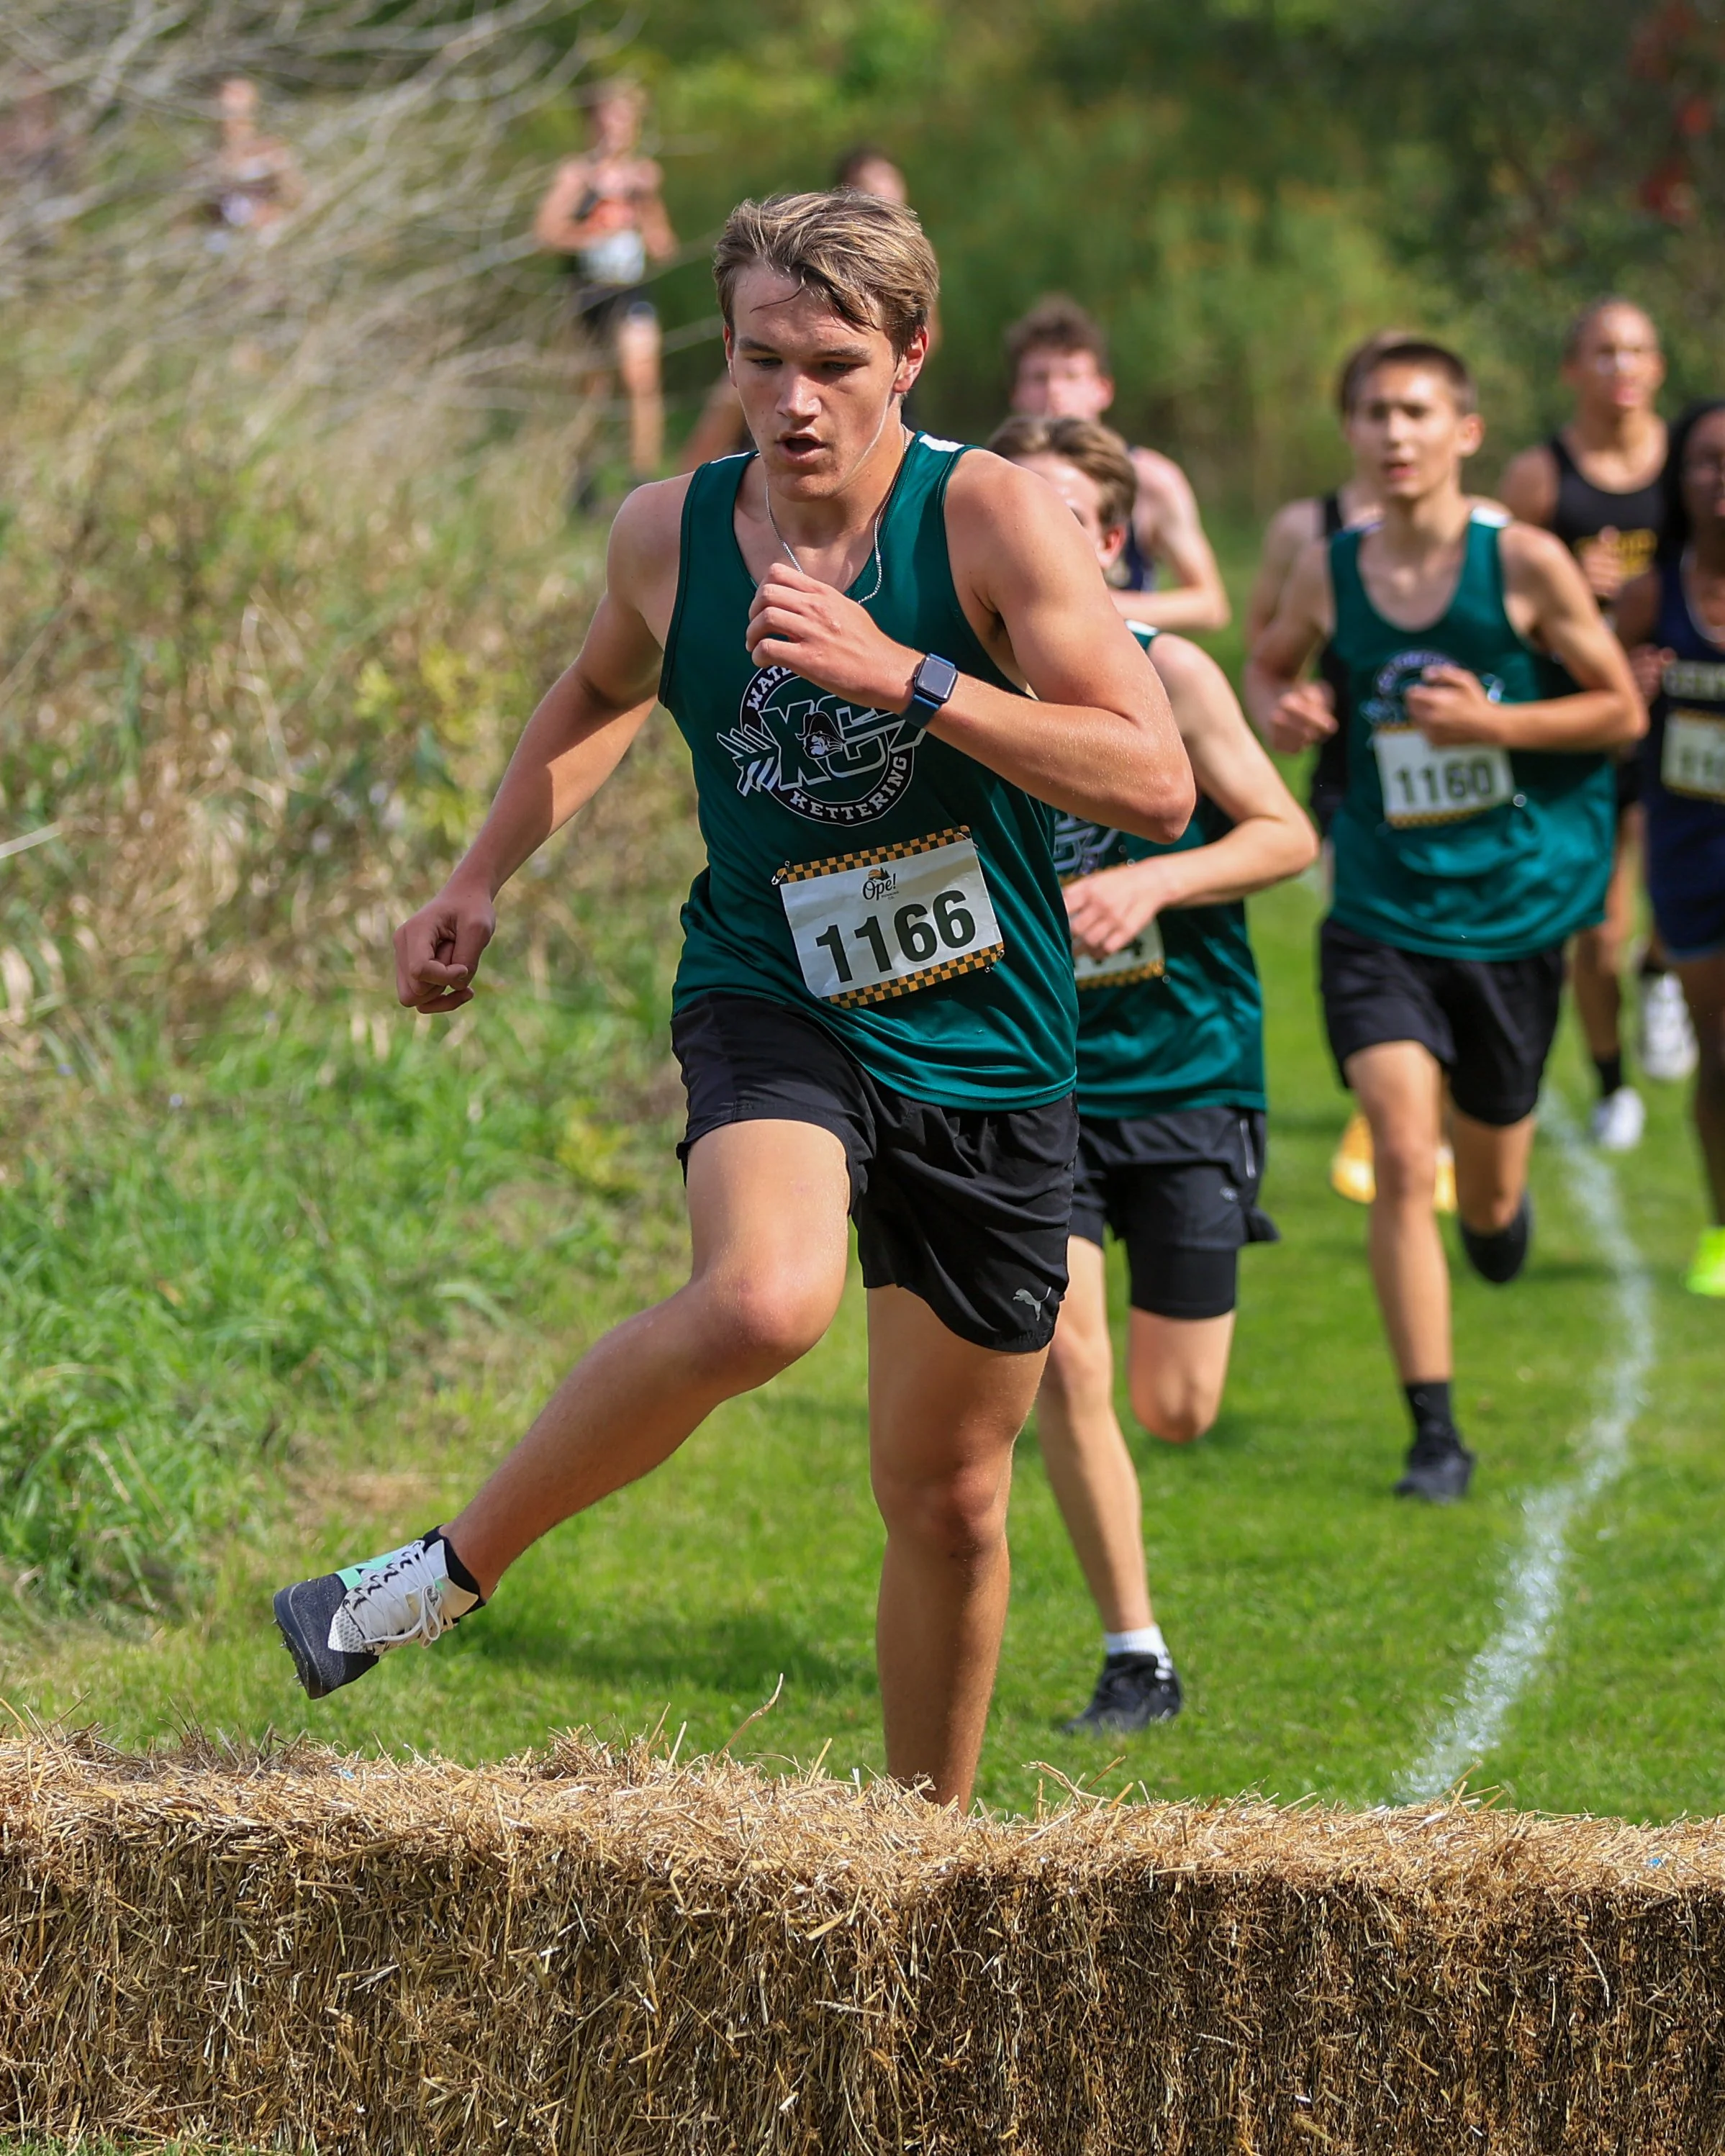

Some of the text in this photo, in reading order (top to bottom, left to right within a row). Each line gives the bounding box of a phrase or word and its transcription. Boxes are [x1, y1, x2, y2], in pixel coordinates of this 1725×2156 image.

[789, 756, 907, 820] KETTERING
[1393, 756, 1495, 805] 1160
[862, 872, 897, 901] Ope!
[815, 889, 976, 983] 1166
